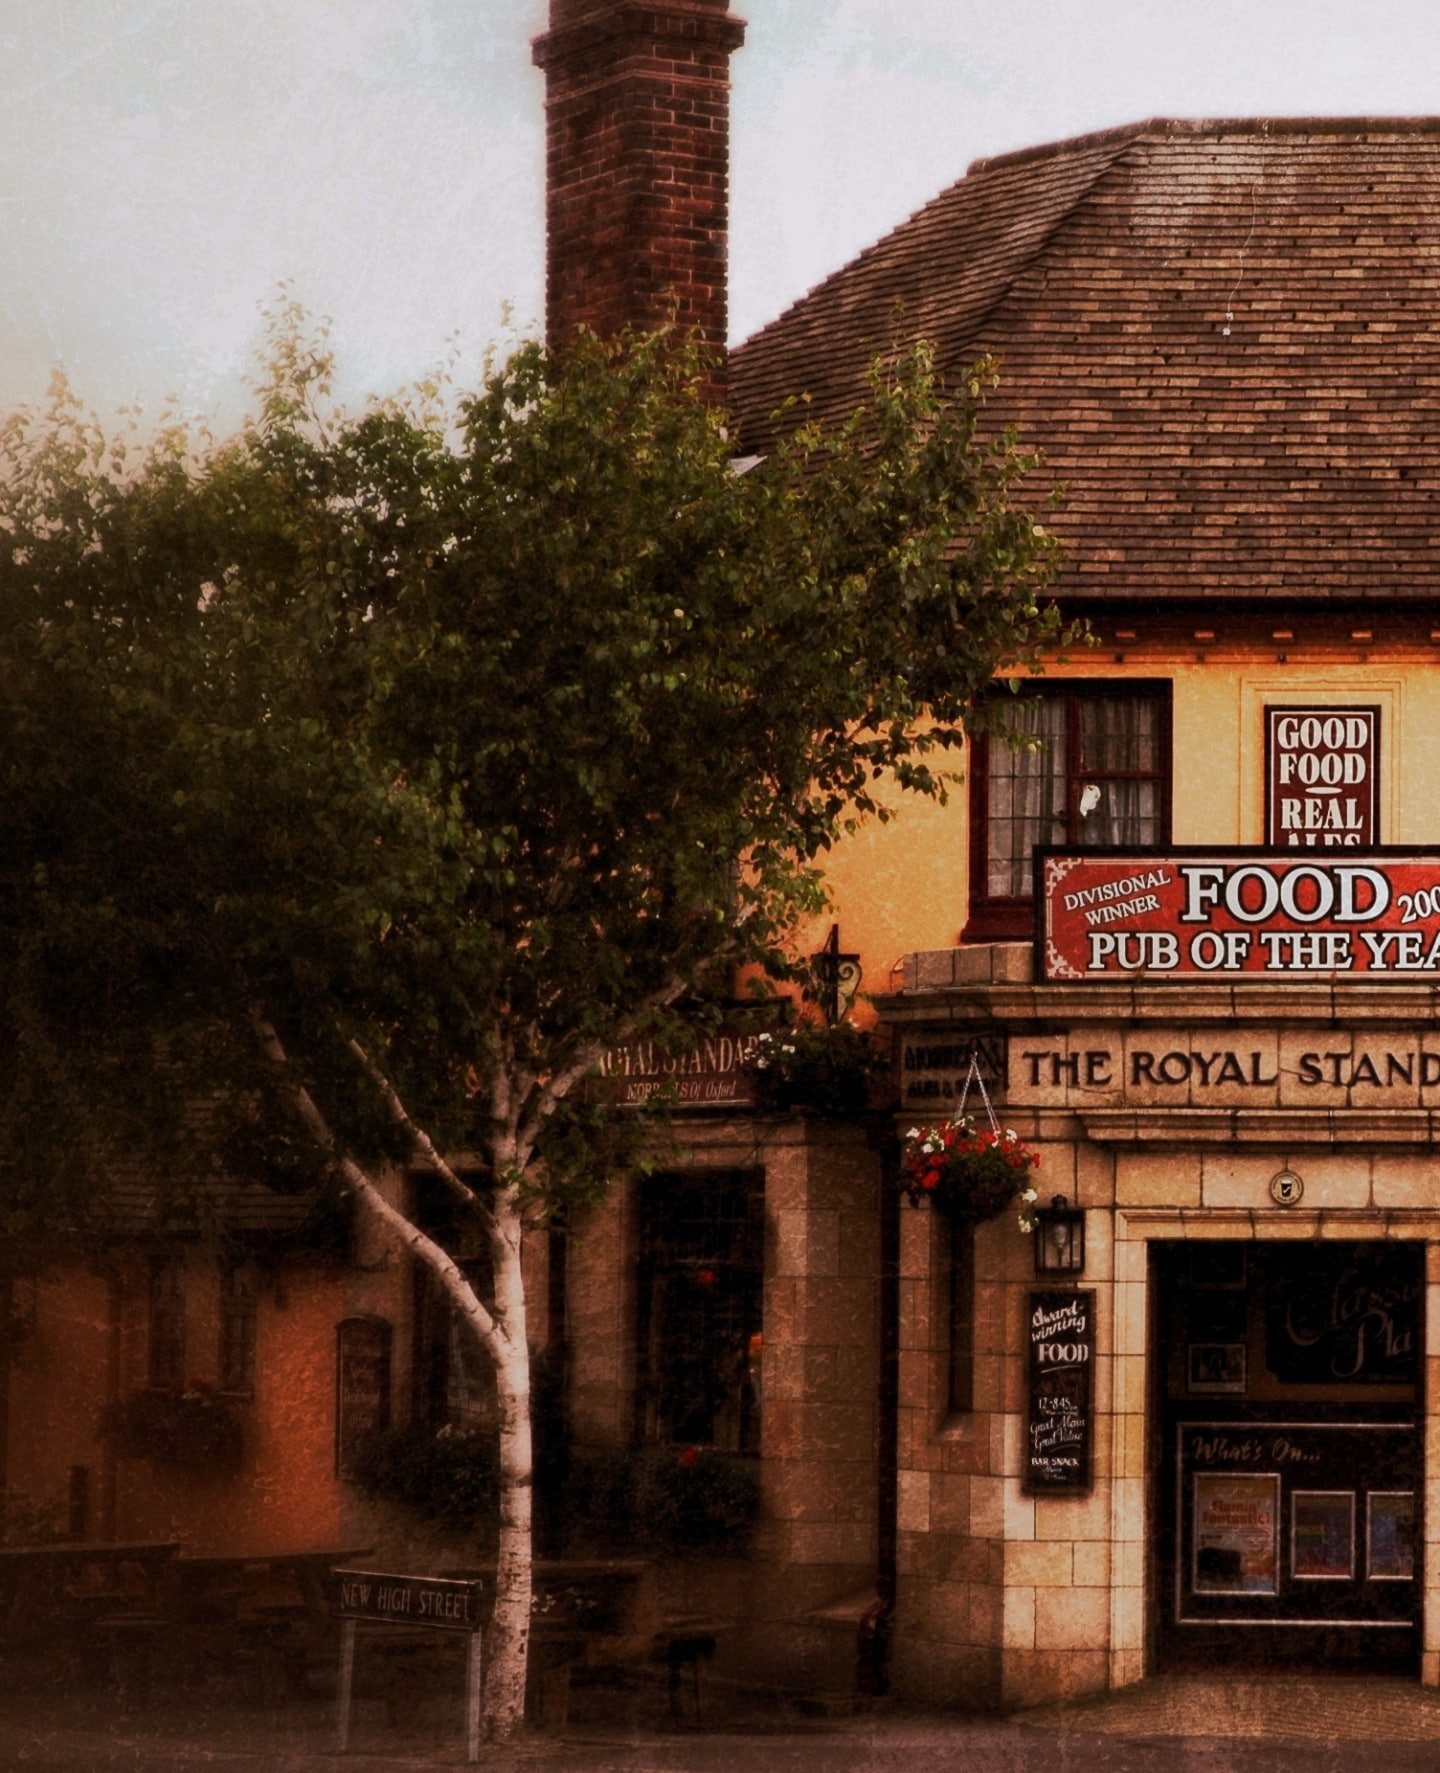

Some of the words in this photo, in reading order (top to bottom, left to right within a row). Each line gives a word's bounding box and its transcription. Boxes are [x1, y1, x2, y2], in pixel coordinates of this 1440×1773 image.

[1277, 717, 1368, 749] GOOD
[1278, 753, 1366, 784] FOOD
[1280, 798, 1364, 830] REAL
[1063, 869, 1171, 912] DIVISIONAL
[1180, 865, 1391, 922] FOOD
[1084, 894, 1160, 926] WINNER
[1086, 931, 1180, 970] PUB
[1190, 931, 1252, 970] OF
[1261, 931, 1353, 970] THE
[1021, 1050, 1112, 1087] THE
[1130, 1050, 1282, 1087] ROYAL
[705, 1080, 737, 1100] Oxford
[1032, 1316, 1086, 1342] winning
[1038, 1344, 1089, 1363] FOOD
[1191, 1435, 1264, 1463] What's
[340, 1582, 372, 1609] NEW
[377, 1586, 411, 1613] HIGH
[418, 1591, 471, 1621] STREET
